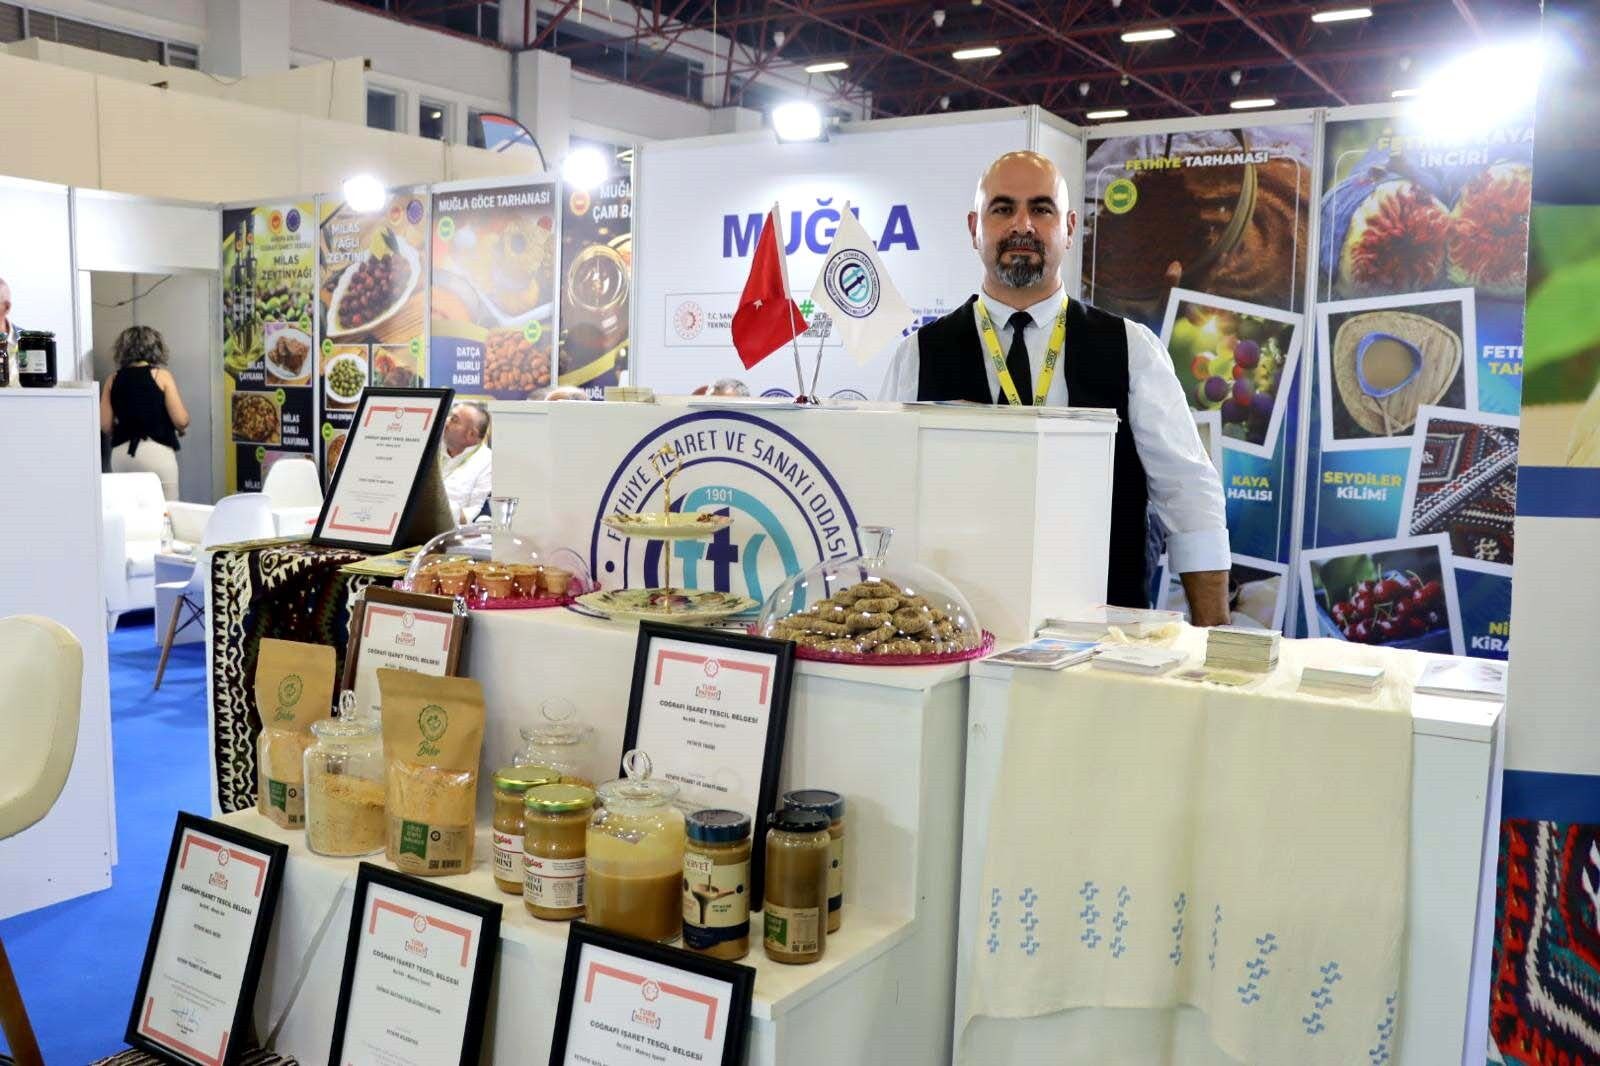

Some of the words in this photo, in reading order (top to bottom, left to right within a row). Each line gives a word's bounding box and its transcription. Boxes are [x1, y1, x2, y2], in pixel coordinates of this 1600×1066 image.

[1125, 157, 1182, 171] FETHİYE
[1183, 152, 1269, 168] TARHANASI
[439, 199, 469, 212] MUĞLA
[471, 195, 495, 209] GÖCE
[496, 191, 550, 208] TARHANASI
[593, 205, 618, 223] ÇAM
[722, 198, 920, 258] MUĞA
[273, 255, 300, 266] MİLAS
[456, 346, 481, 359] DATÇA
[452, 373, 481, 385] BADEMİ
[1232, 474, 1270, 488] KAYA
[1323, 470, 1402, 487] SEYDİLER
[607, 466, 651, 542] FTHİYE
[725, 431, 747, 453] VE
[751, 438, 815, 496] SANAYİ
[809, 494, 848, 560] ODASI
[704, 488, 733, 502] 1901
[1336, 486, 1387, 501] KİLİMİ
